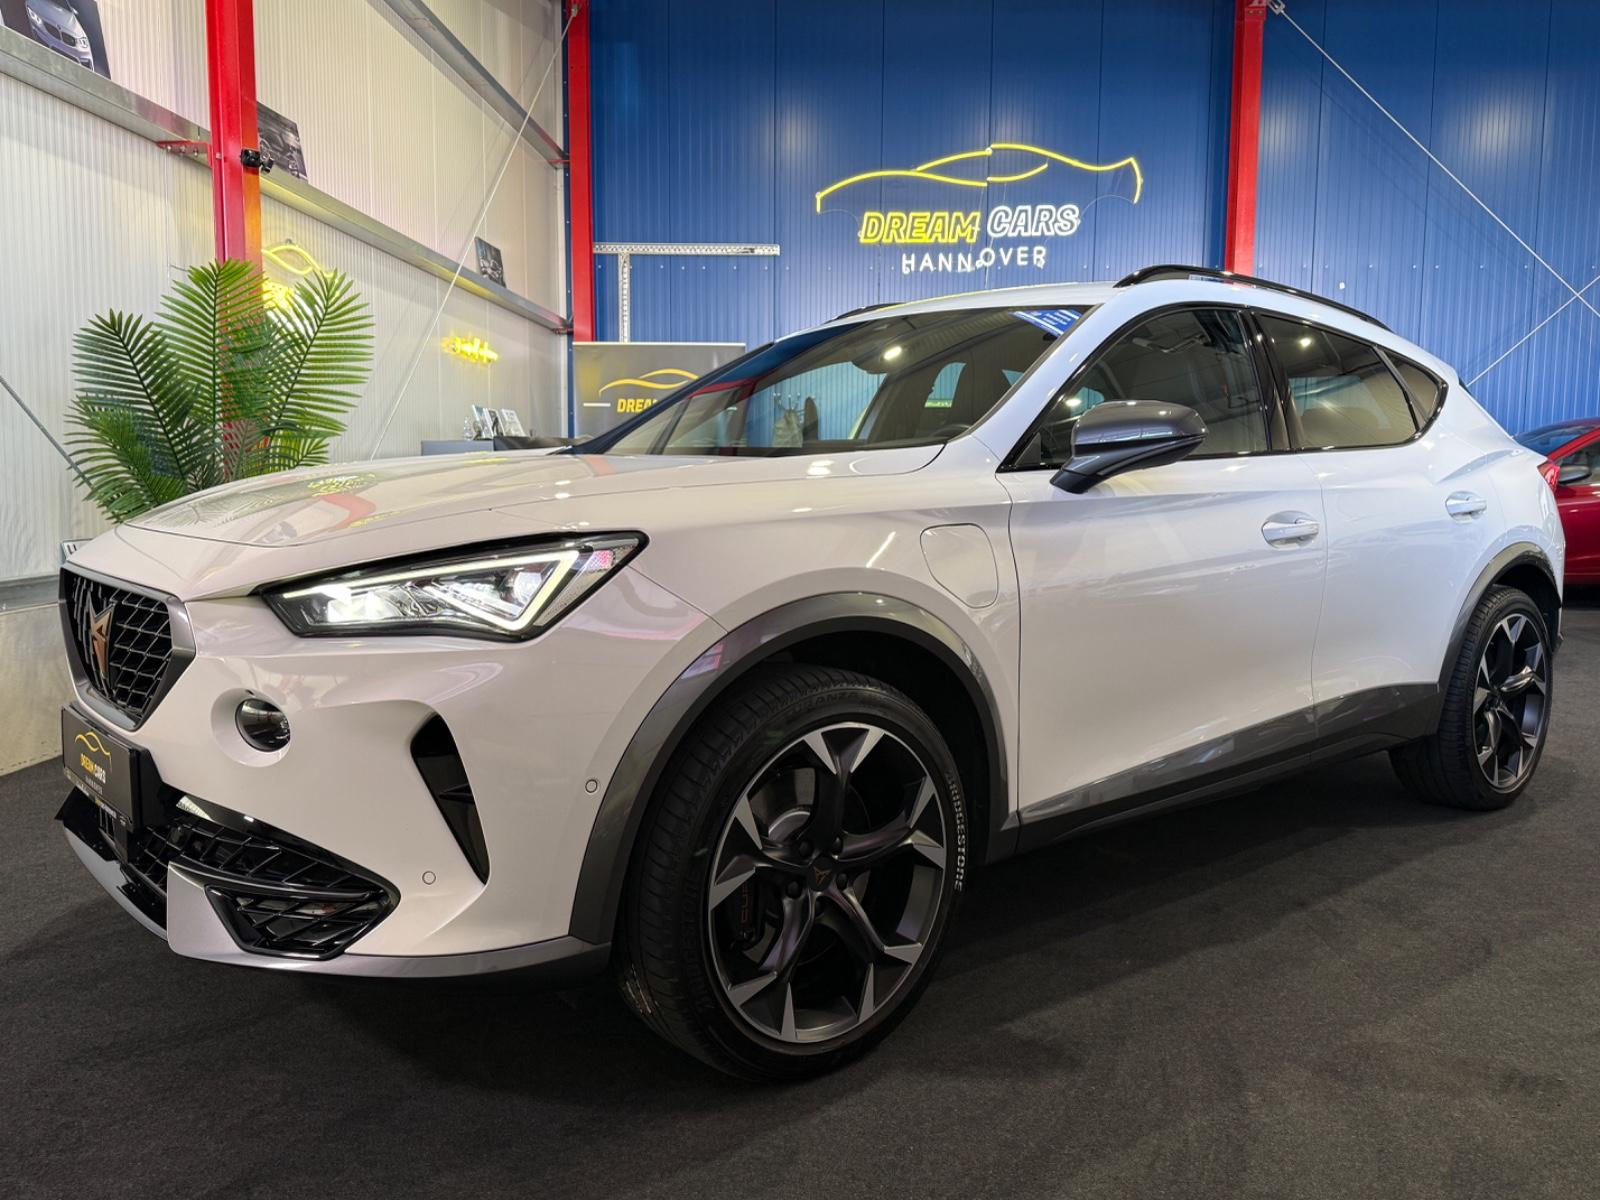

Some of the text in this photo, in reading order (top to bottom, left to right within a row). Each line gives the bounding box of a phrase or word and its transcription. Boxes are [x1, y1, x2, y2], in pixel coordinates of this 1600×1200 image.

[860, 204, 1079, 243] DREAM CARS
[902, 246, 1047, 274] HANNOVER
[617, 398, 657, 413] DREA
[946, 771, 966, 892] BRIDGESTONE
